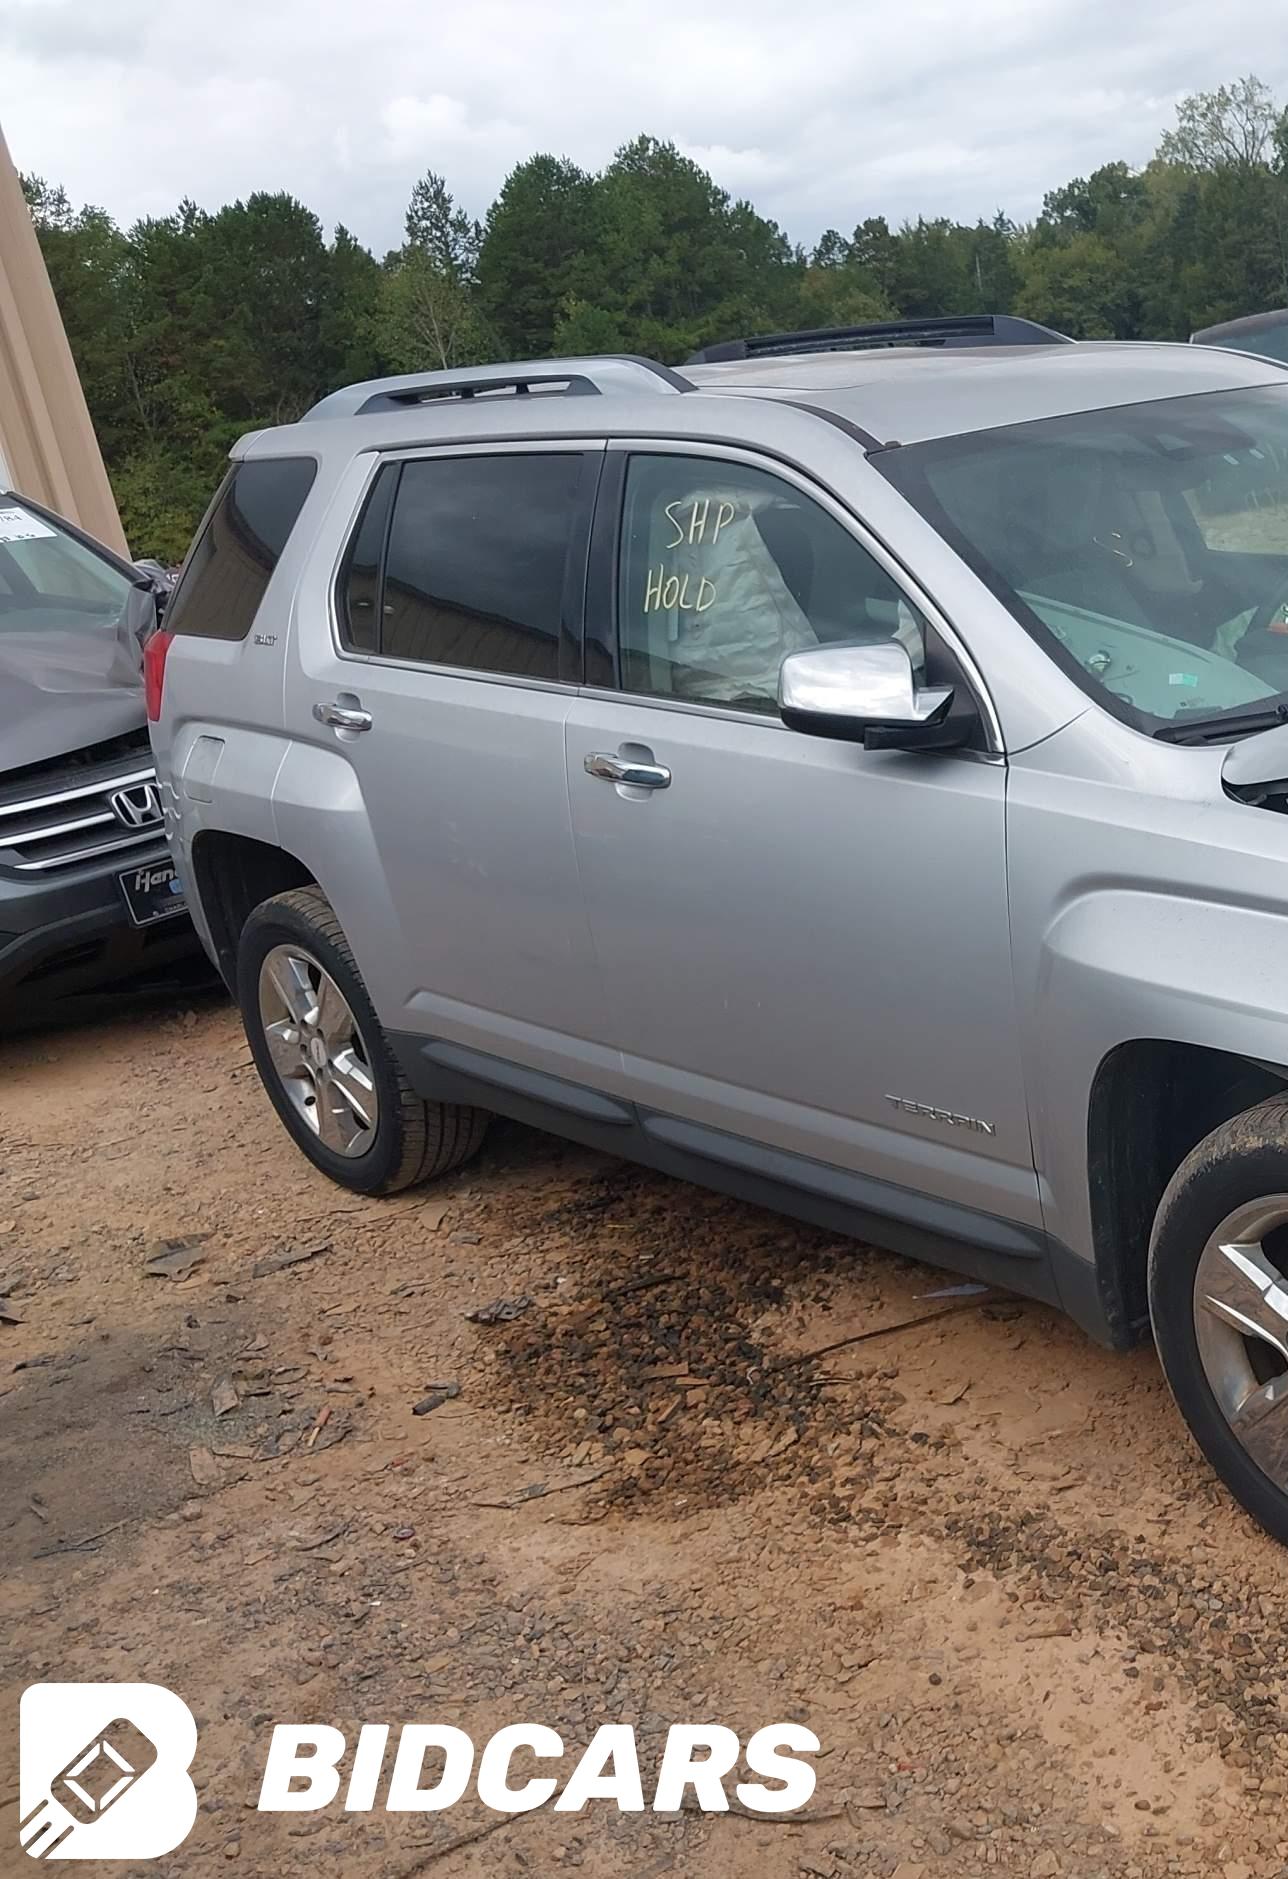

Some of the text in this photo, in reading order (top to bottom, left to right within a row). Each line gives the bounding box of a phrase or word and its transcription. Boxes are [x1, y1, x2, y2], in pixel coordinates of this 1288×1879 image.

[665, 499, 735, 549] SHP
[643, 563, 716, 613] HOLD
[885, 1094, 996, 1136] TERRAIN
